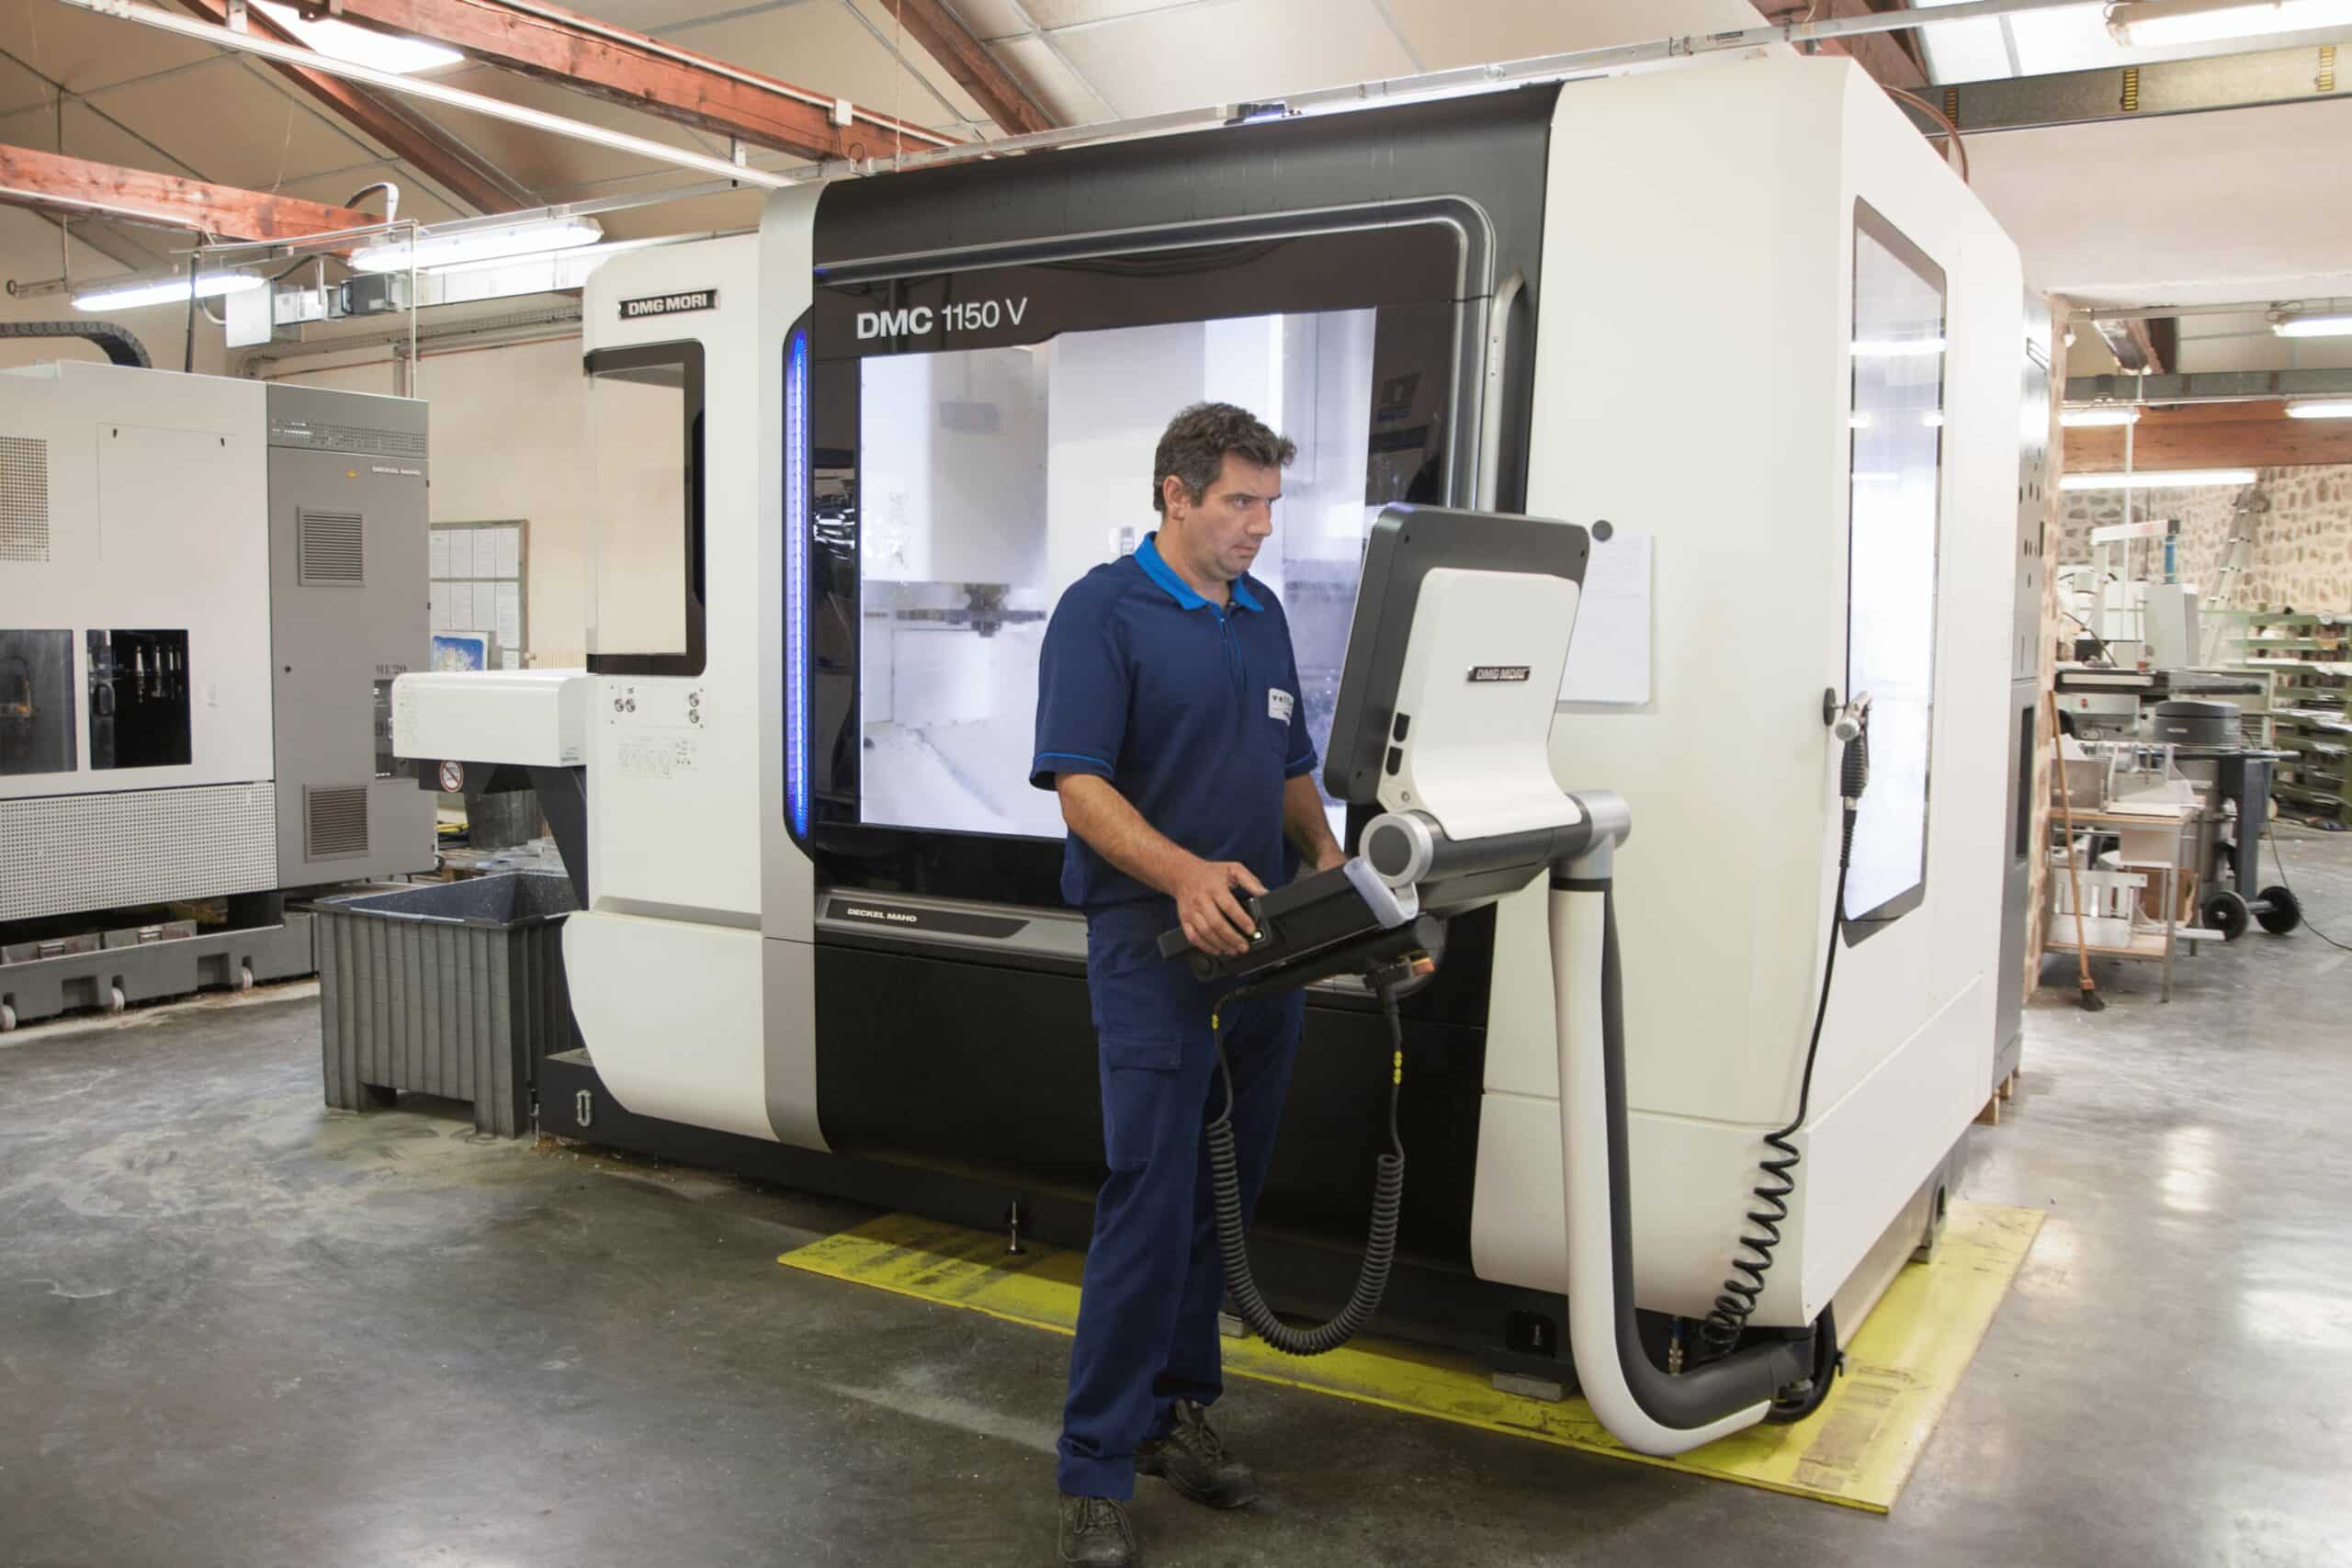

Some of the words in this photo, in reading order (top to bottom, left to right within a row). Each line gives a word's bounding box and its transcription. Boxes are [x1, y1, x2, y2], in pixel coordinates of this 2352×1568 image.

[628, 299, 664, 316] DMG
[665, 293, 707, 311] MORI
[856, 306, 933, 339] DMC
[941, 300, 1001, 332] 1150
[1005, 297, 1028, 326] V
[846, 908, 886, 919] DECKEL
[886, 912, 918, 923] MAHO
